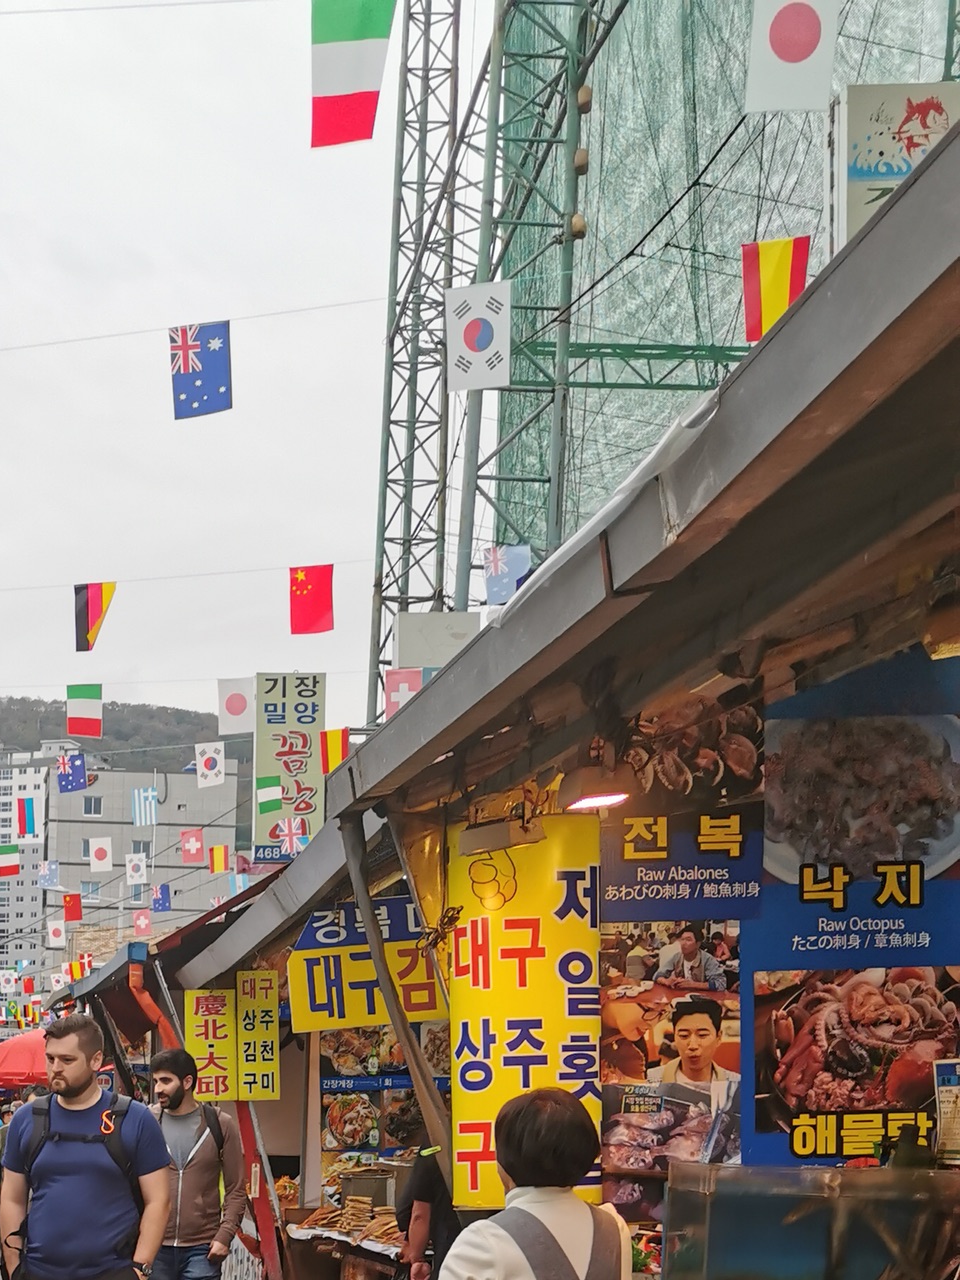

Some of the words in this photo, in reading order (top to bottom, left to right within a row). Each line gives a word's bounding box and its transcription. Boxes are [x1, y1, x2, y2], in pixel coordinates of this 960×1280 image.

[264, 675, 319, 698] 기장
[264, 702, 319, 724] 밀양
[637, 867, 665, 881] Raw
[668, 865, 729, 880] Abalones
[605, 883, 691, 900] あわびの刺身
[703, 881, 760, 897] 鮑魚刺身
[818, 918, 846, 932] Raw
[850, 917, 905, 933] Octopus
[792, 934, 861, 951] たこの刺身
[874, 931, 931, 948] 章魚刺身
[453, 917, 546, 990] 대구
[242, 978, 274, 999] 대구
[303, 950, 380, 1019] 대구
[396, 947, 438, 1012] 김
[242, 1009, 274, 1031] 상주
[243, 1040, 274, 1062] 김천
[455, 1018, 548, 1091] 상주
[243, 1072, 275, 1093] 구미
[456, 1122, 497, 1191] 구
